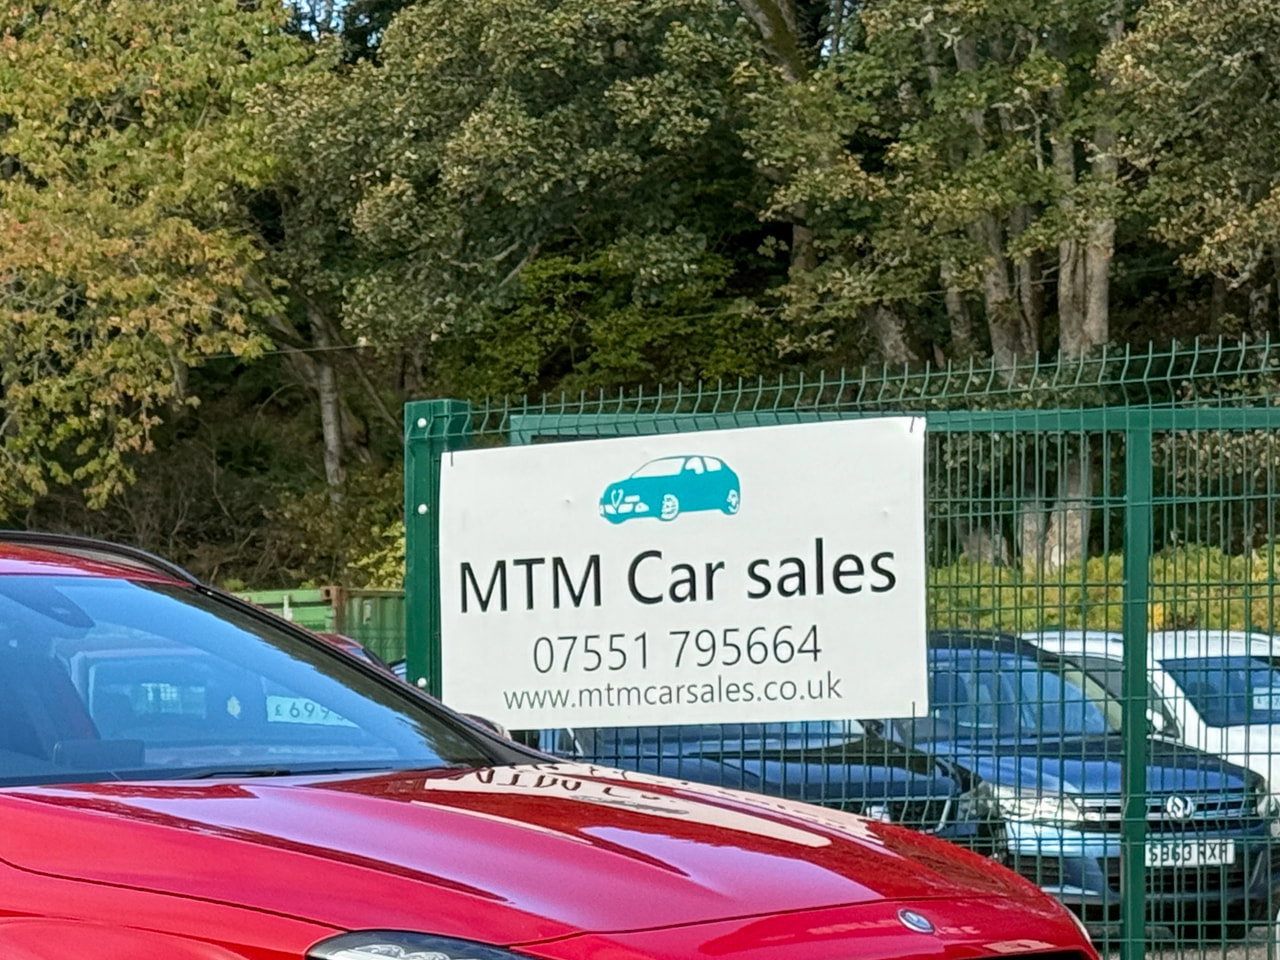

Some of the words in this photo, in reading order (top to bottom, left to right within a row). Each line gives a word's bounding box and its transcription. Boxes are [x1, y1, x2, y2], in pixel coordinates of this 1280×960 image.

[460, 554, 602, 614] MTM
[627, 549, 725, 605] Car
[747, 537, 897, 600] sales
[533, 631, 647, 674] 07551
[669, 624, 822, 668] 795664
[503, 669, 842, 710] www.mtmcarsales.co.uk
